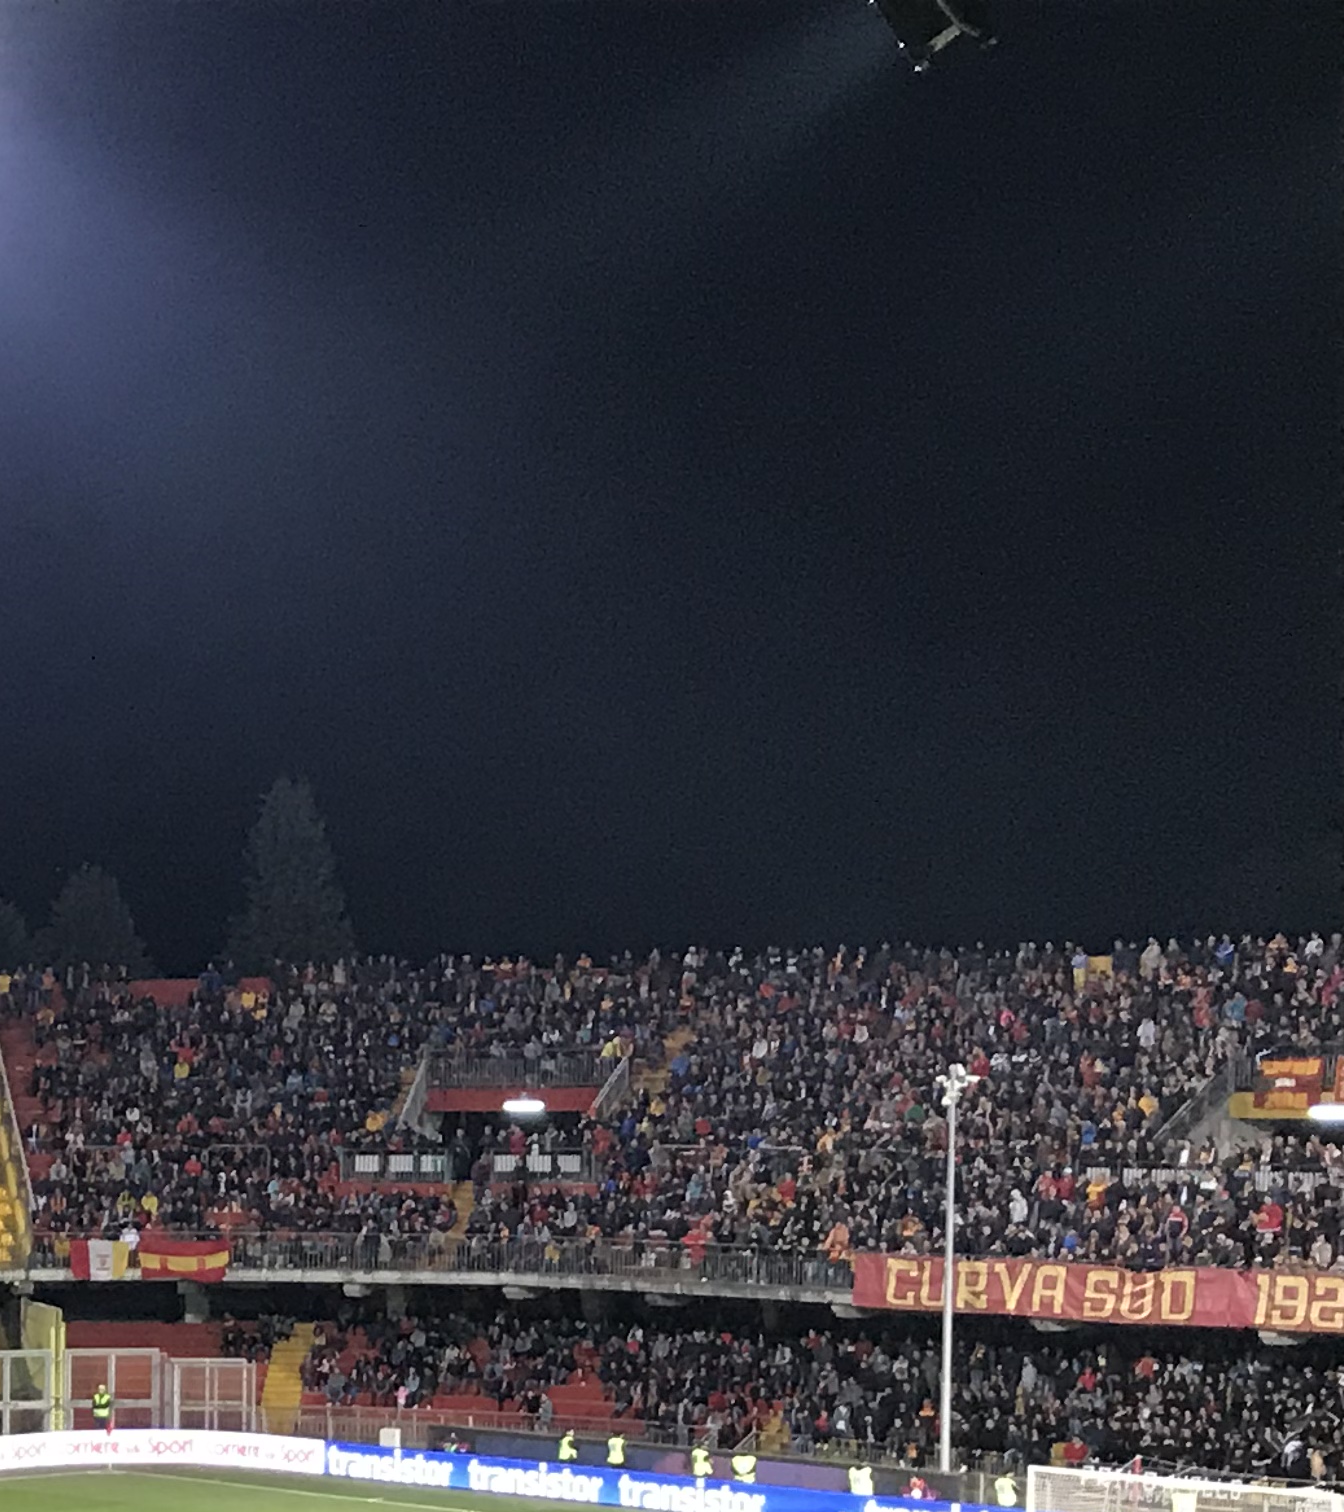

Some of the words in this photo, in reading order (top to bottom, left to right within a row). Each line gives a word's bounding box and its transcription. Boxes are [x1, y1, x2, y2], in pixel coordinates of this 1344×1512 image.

[886, 1258, 1067, 1314] CURVA
[1254, 1274, 1344, 1328] 192
[66, 1440, 120, 1455] orriere
[212, 1442, 260, 1458] orriere
[327, 1444, 454, 1488] transistor
[467, 1458, 604, 1503] transistor
